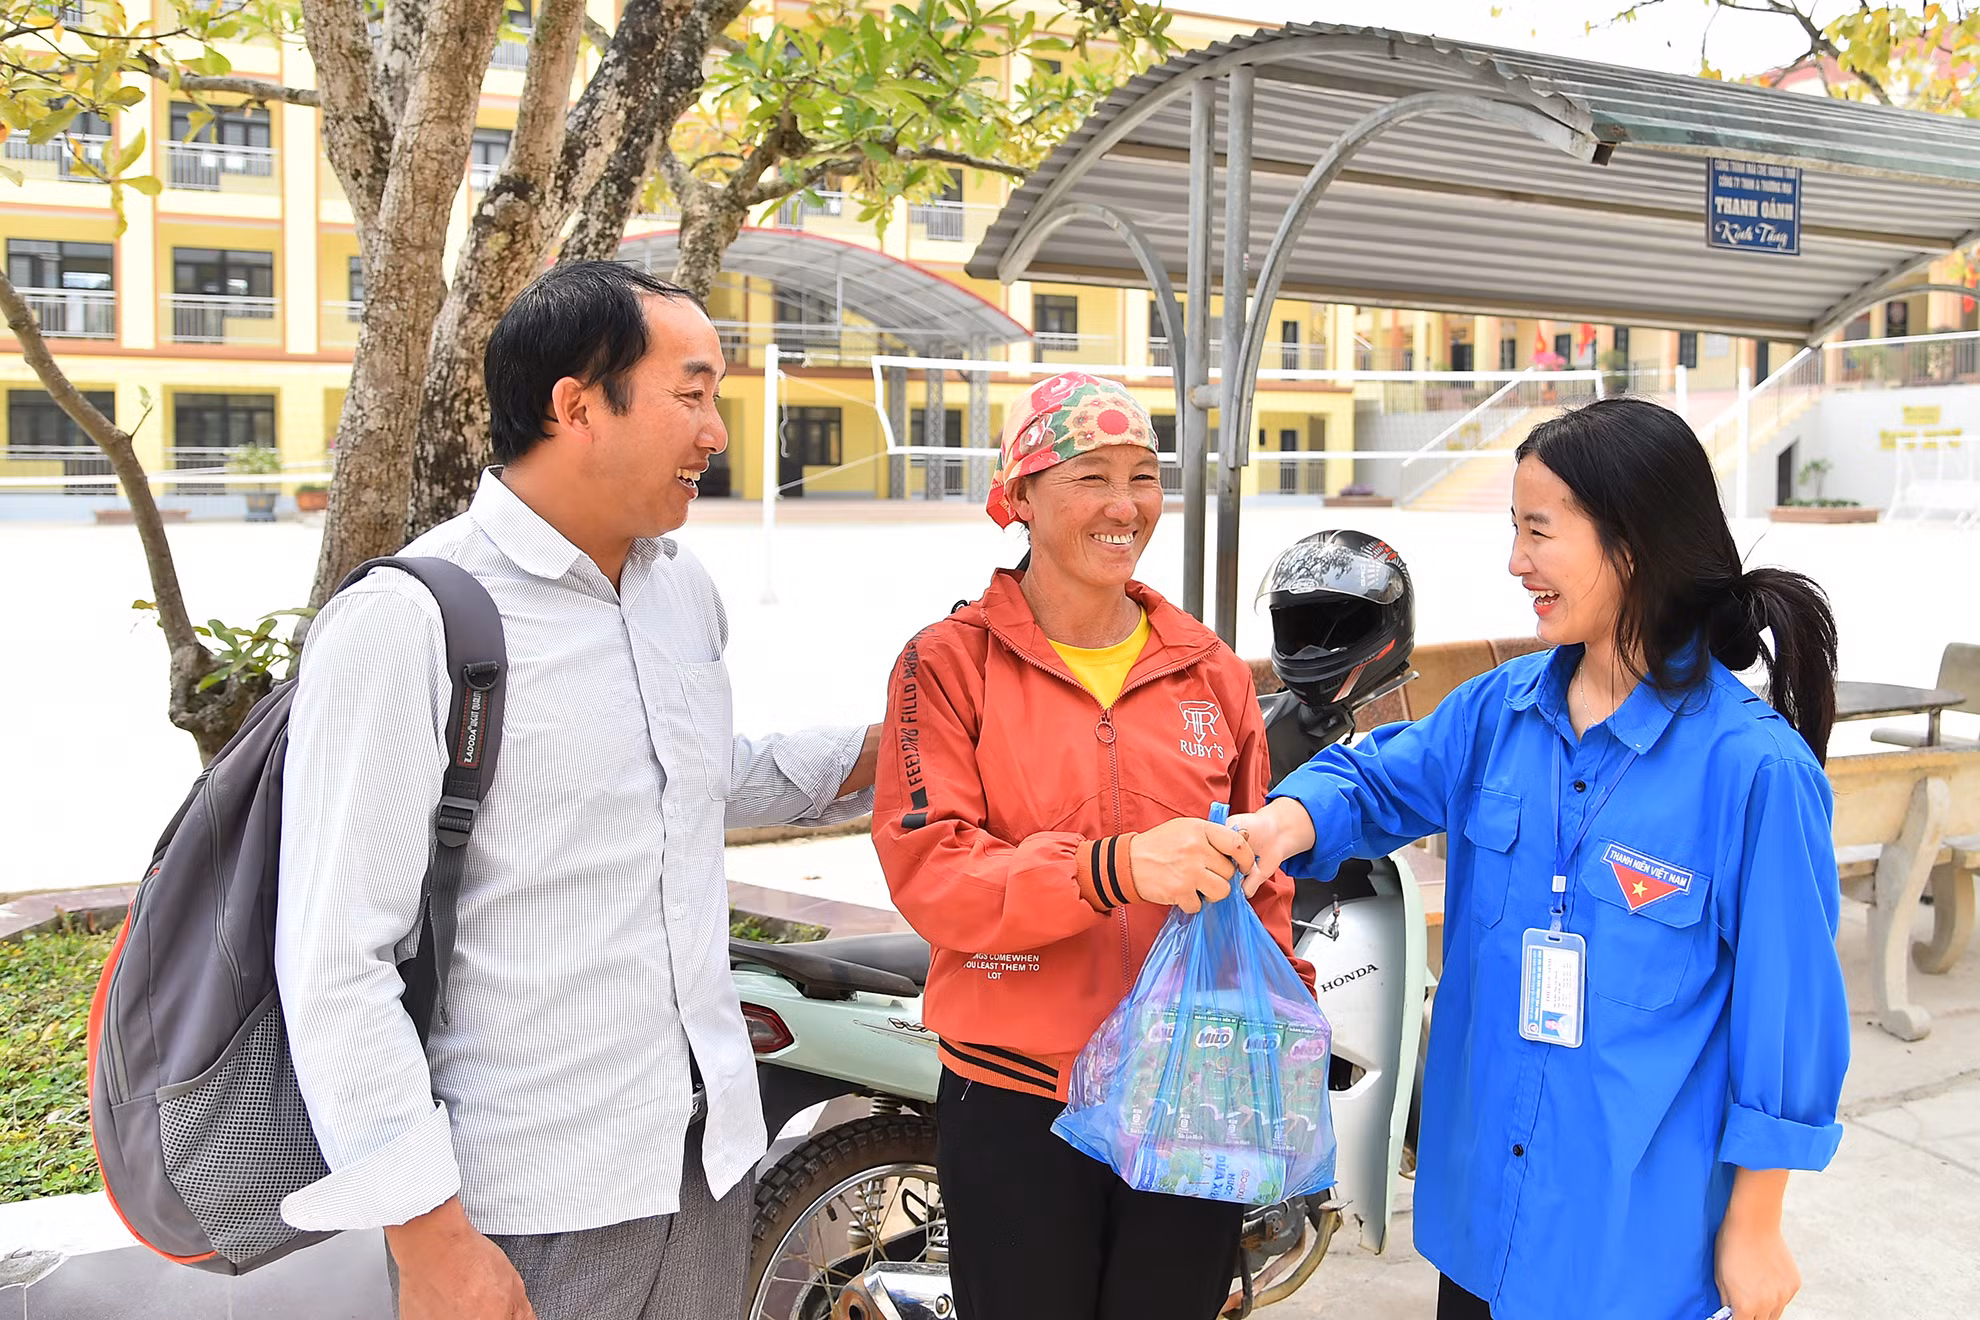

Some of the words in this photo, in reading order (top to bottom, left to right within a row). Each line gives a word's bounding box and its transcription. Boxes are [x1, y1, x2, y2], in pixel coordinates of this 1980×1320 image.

[1715, 196, 1758, 217] THANH
[901, 683, 918, 723] FILLD
[1179, 739, 1225, 759] RUBY'S
[1610, 850, 1633, 866] THANH
[1651, 867, 1669, 880] VIỆT
[1669, 874, 1687, 886] NAM
[977, 961, 998, 970] LEAST
[1000, 963, 1026, 971] THEM
[987, 971, 1002, 980] LOT
[1321, 963, 1379, 993] HONDA
[1198, 1032, 1230, 1044] MILO
